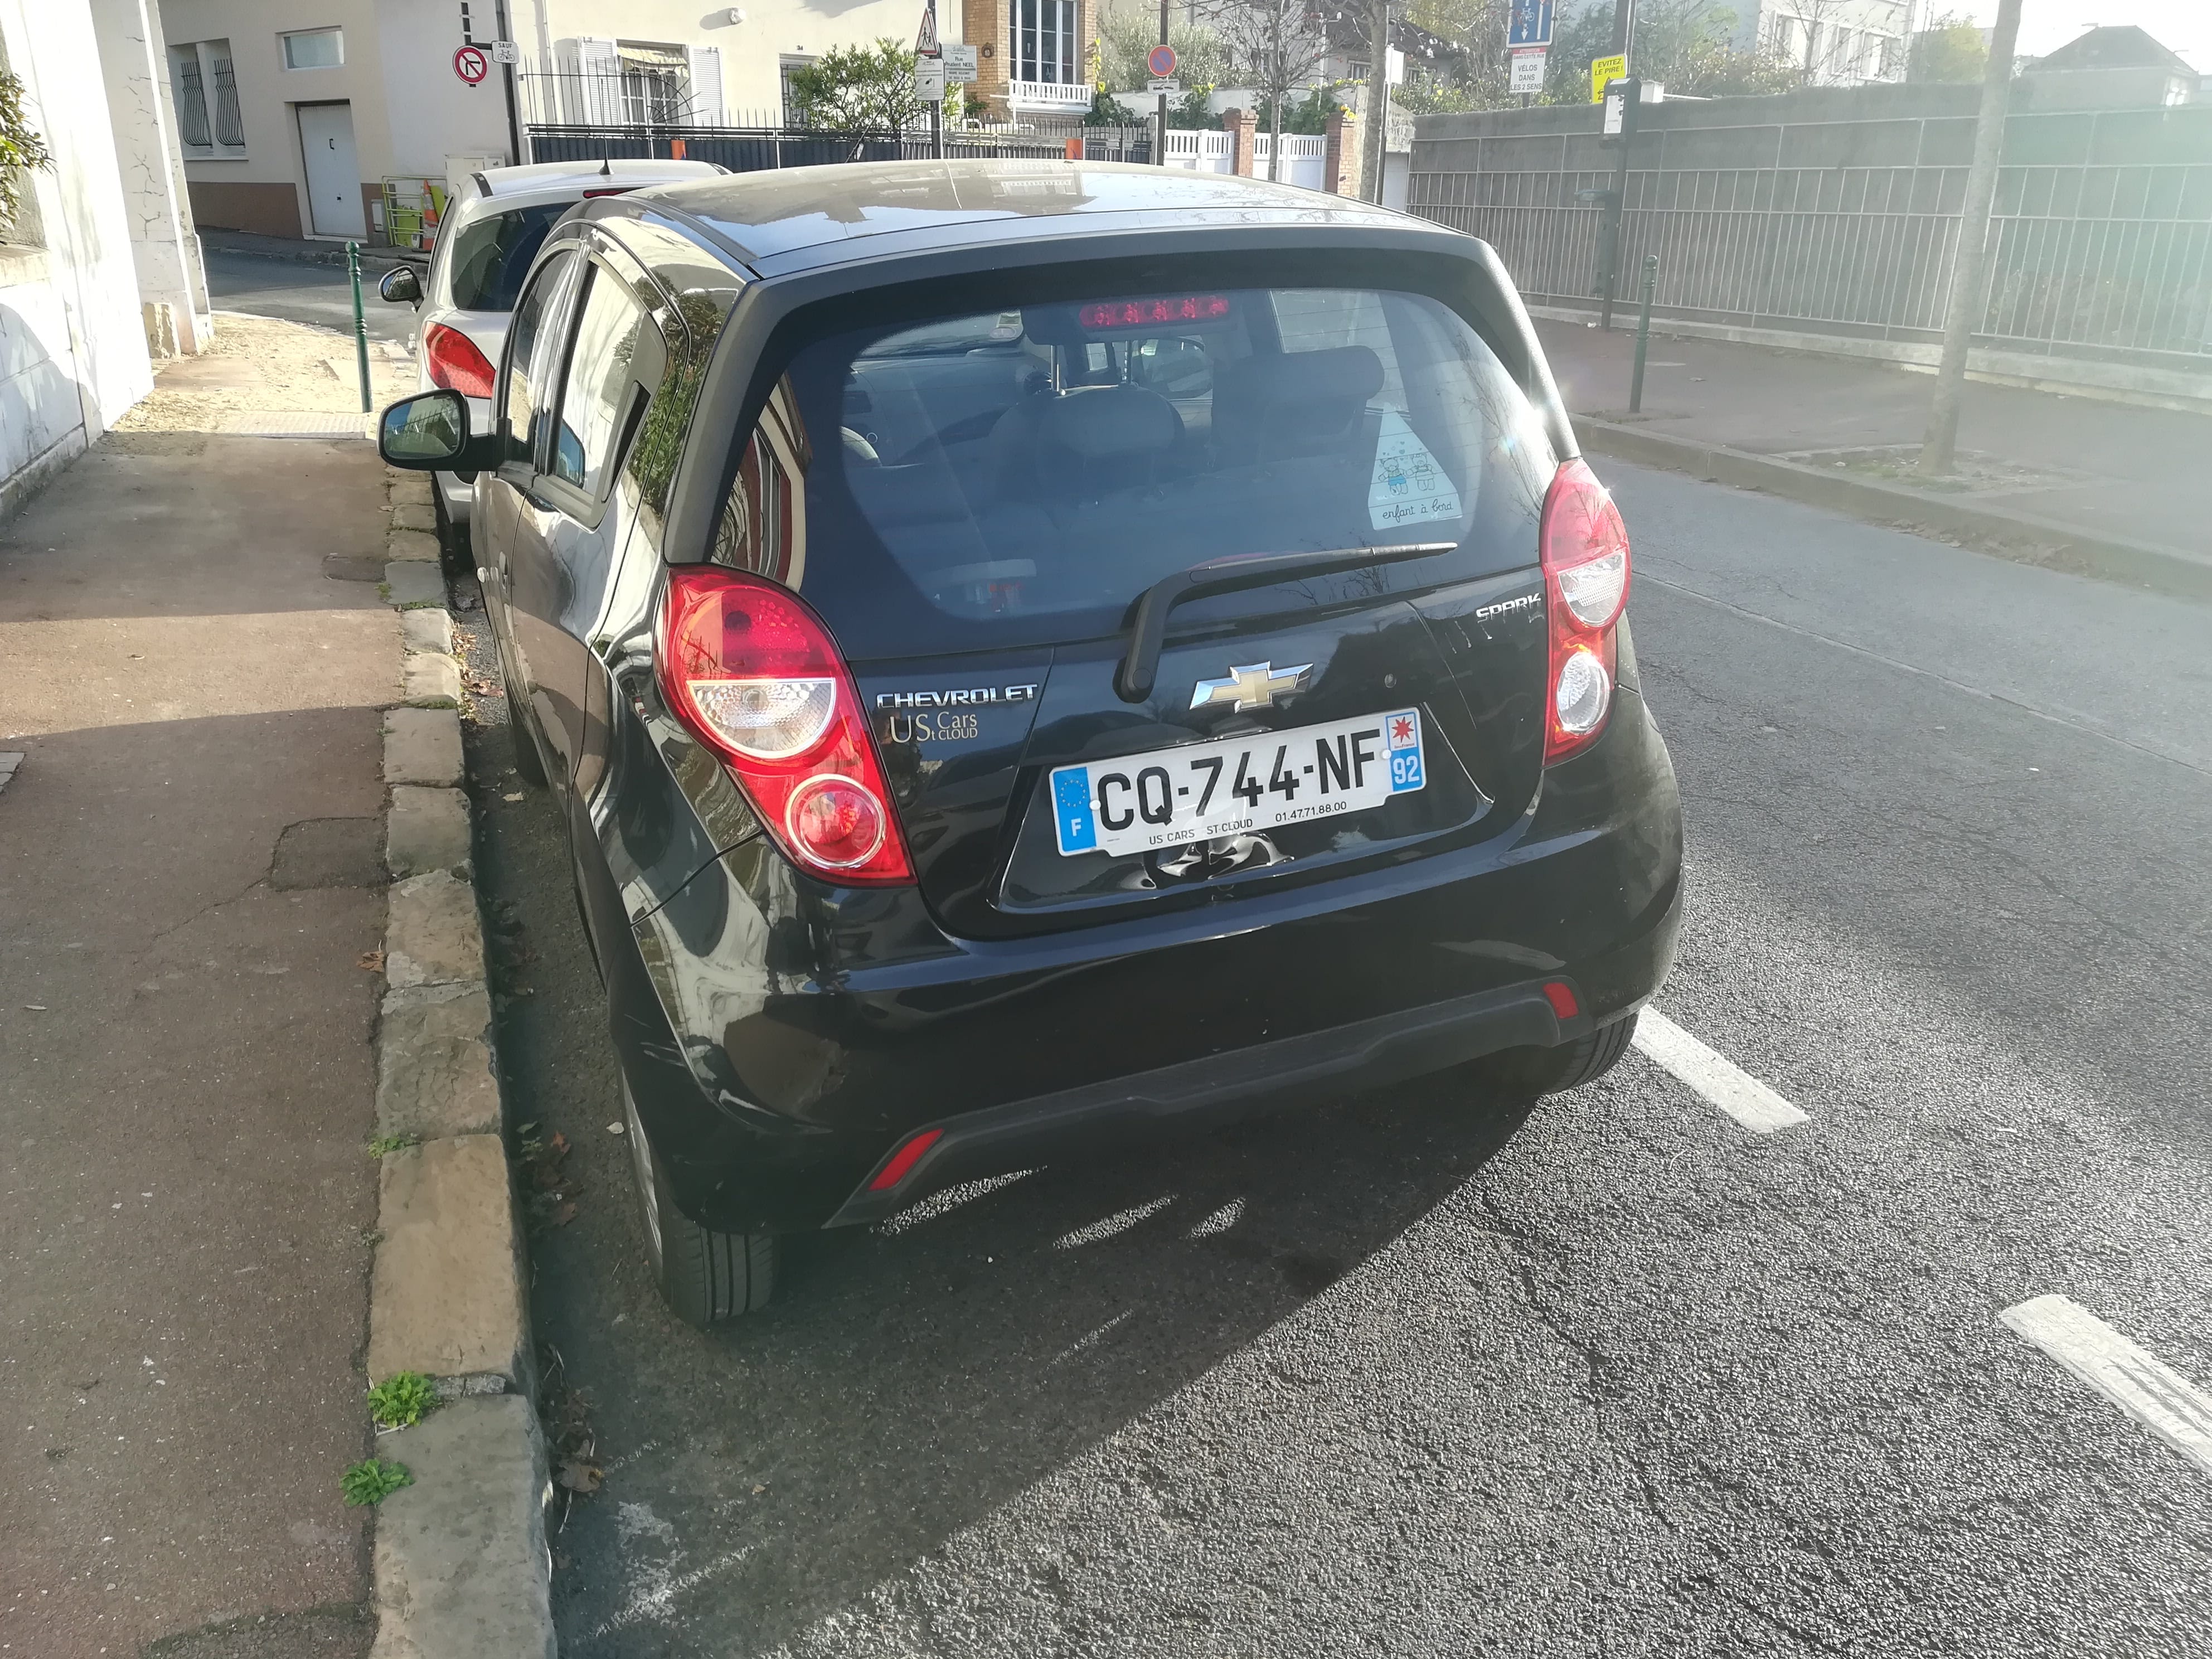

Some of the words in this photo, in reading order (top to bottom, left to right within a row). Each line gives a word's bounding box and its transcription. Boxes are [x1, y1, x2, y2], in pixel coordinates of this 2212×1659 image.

[1518, 64, 1538, 72] VÉLOS
[1598, 58, 1622, 68] EVITEZ
[1604, 66, 1619, 74] PIRE
[1382, 505, 1415, 523] enfant
[1420, 504, 1428, 513] à
[1432, 498, 1453, 512] bord
[1476, 593, 1541, 623] SPARK
[876, 683, 1038, 709] CHEVROLET
[937, 711, 977, 730] Cars
[938, 727, 978, 741] CLOUD
[1098, 728, 1381, 831] CQ-744-NF
[1393, 755, 1420, 784] 92
[1071, 818, 1082, 837] F
[1149, 835, 1163, 845] US
[1167, 829, 1195, 842] CARS
[1275, 801, 1347, 822] 01.47.71.88.00
